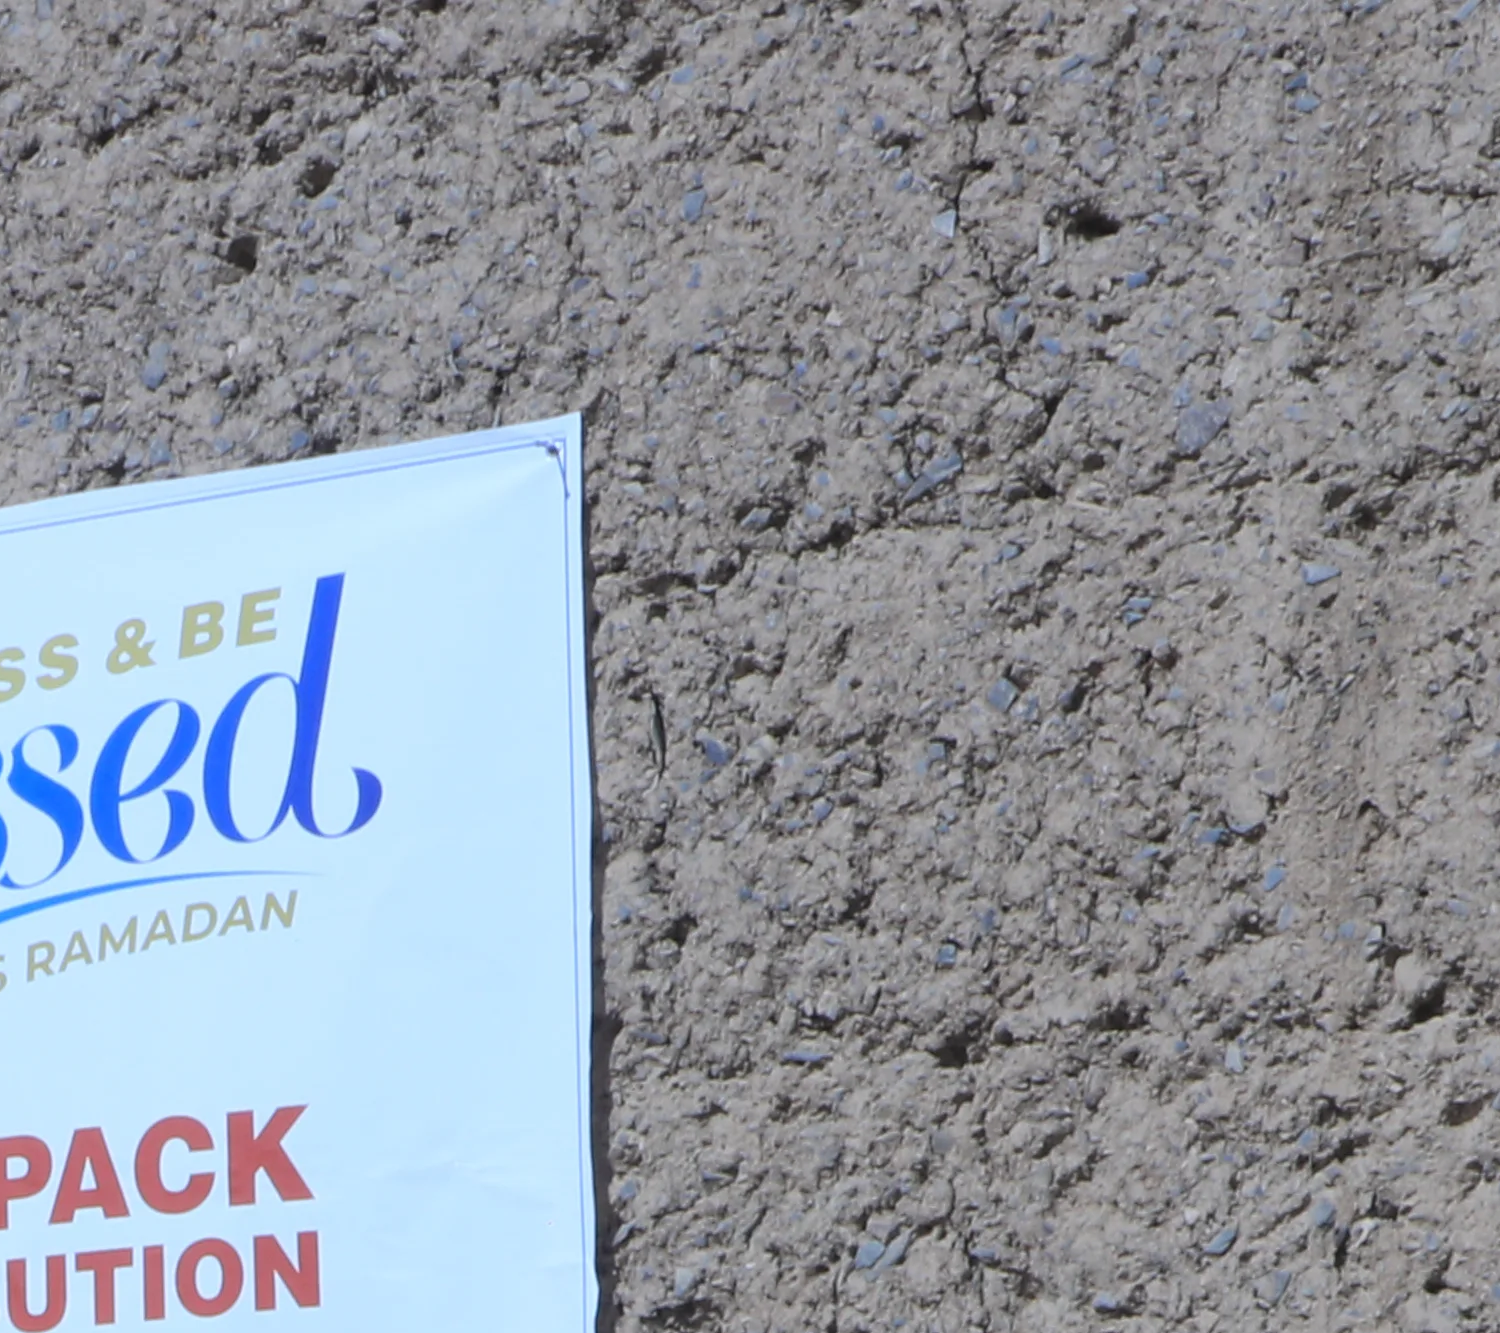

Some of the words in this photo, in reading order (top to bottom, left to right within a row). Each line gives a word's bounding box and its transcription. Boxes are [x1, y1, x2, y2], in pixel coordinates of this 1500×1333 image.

[106, 617, 157, 675] &
[178, 586, 283, 660] BE
[25, 889, 299, 982] RAMADAN
